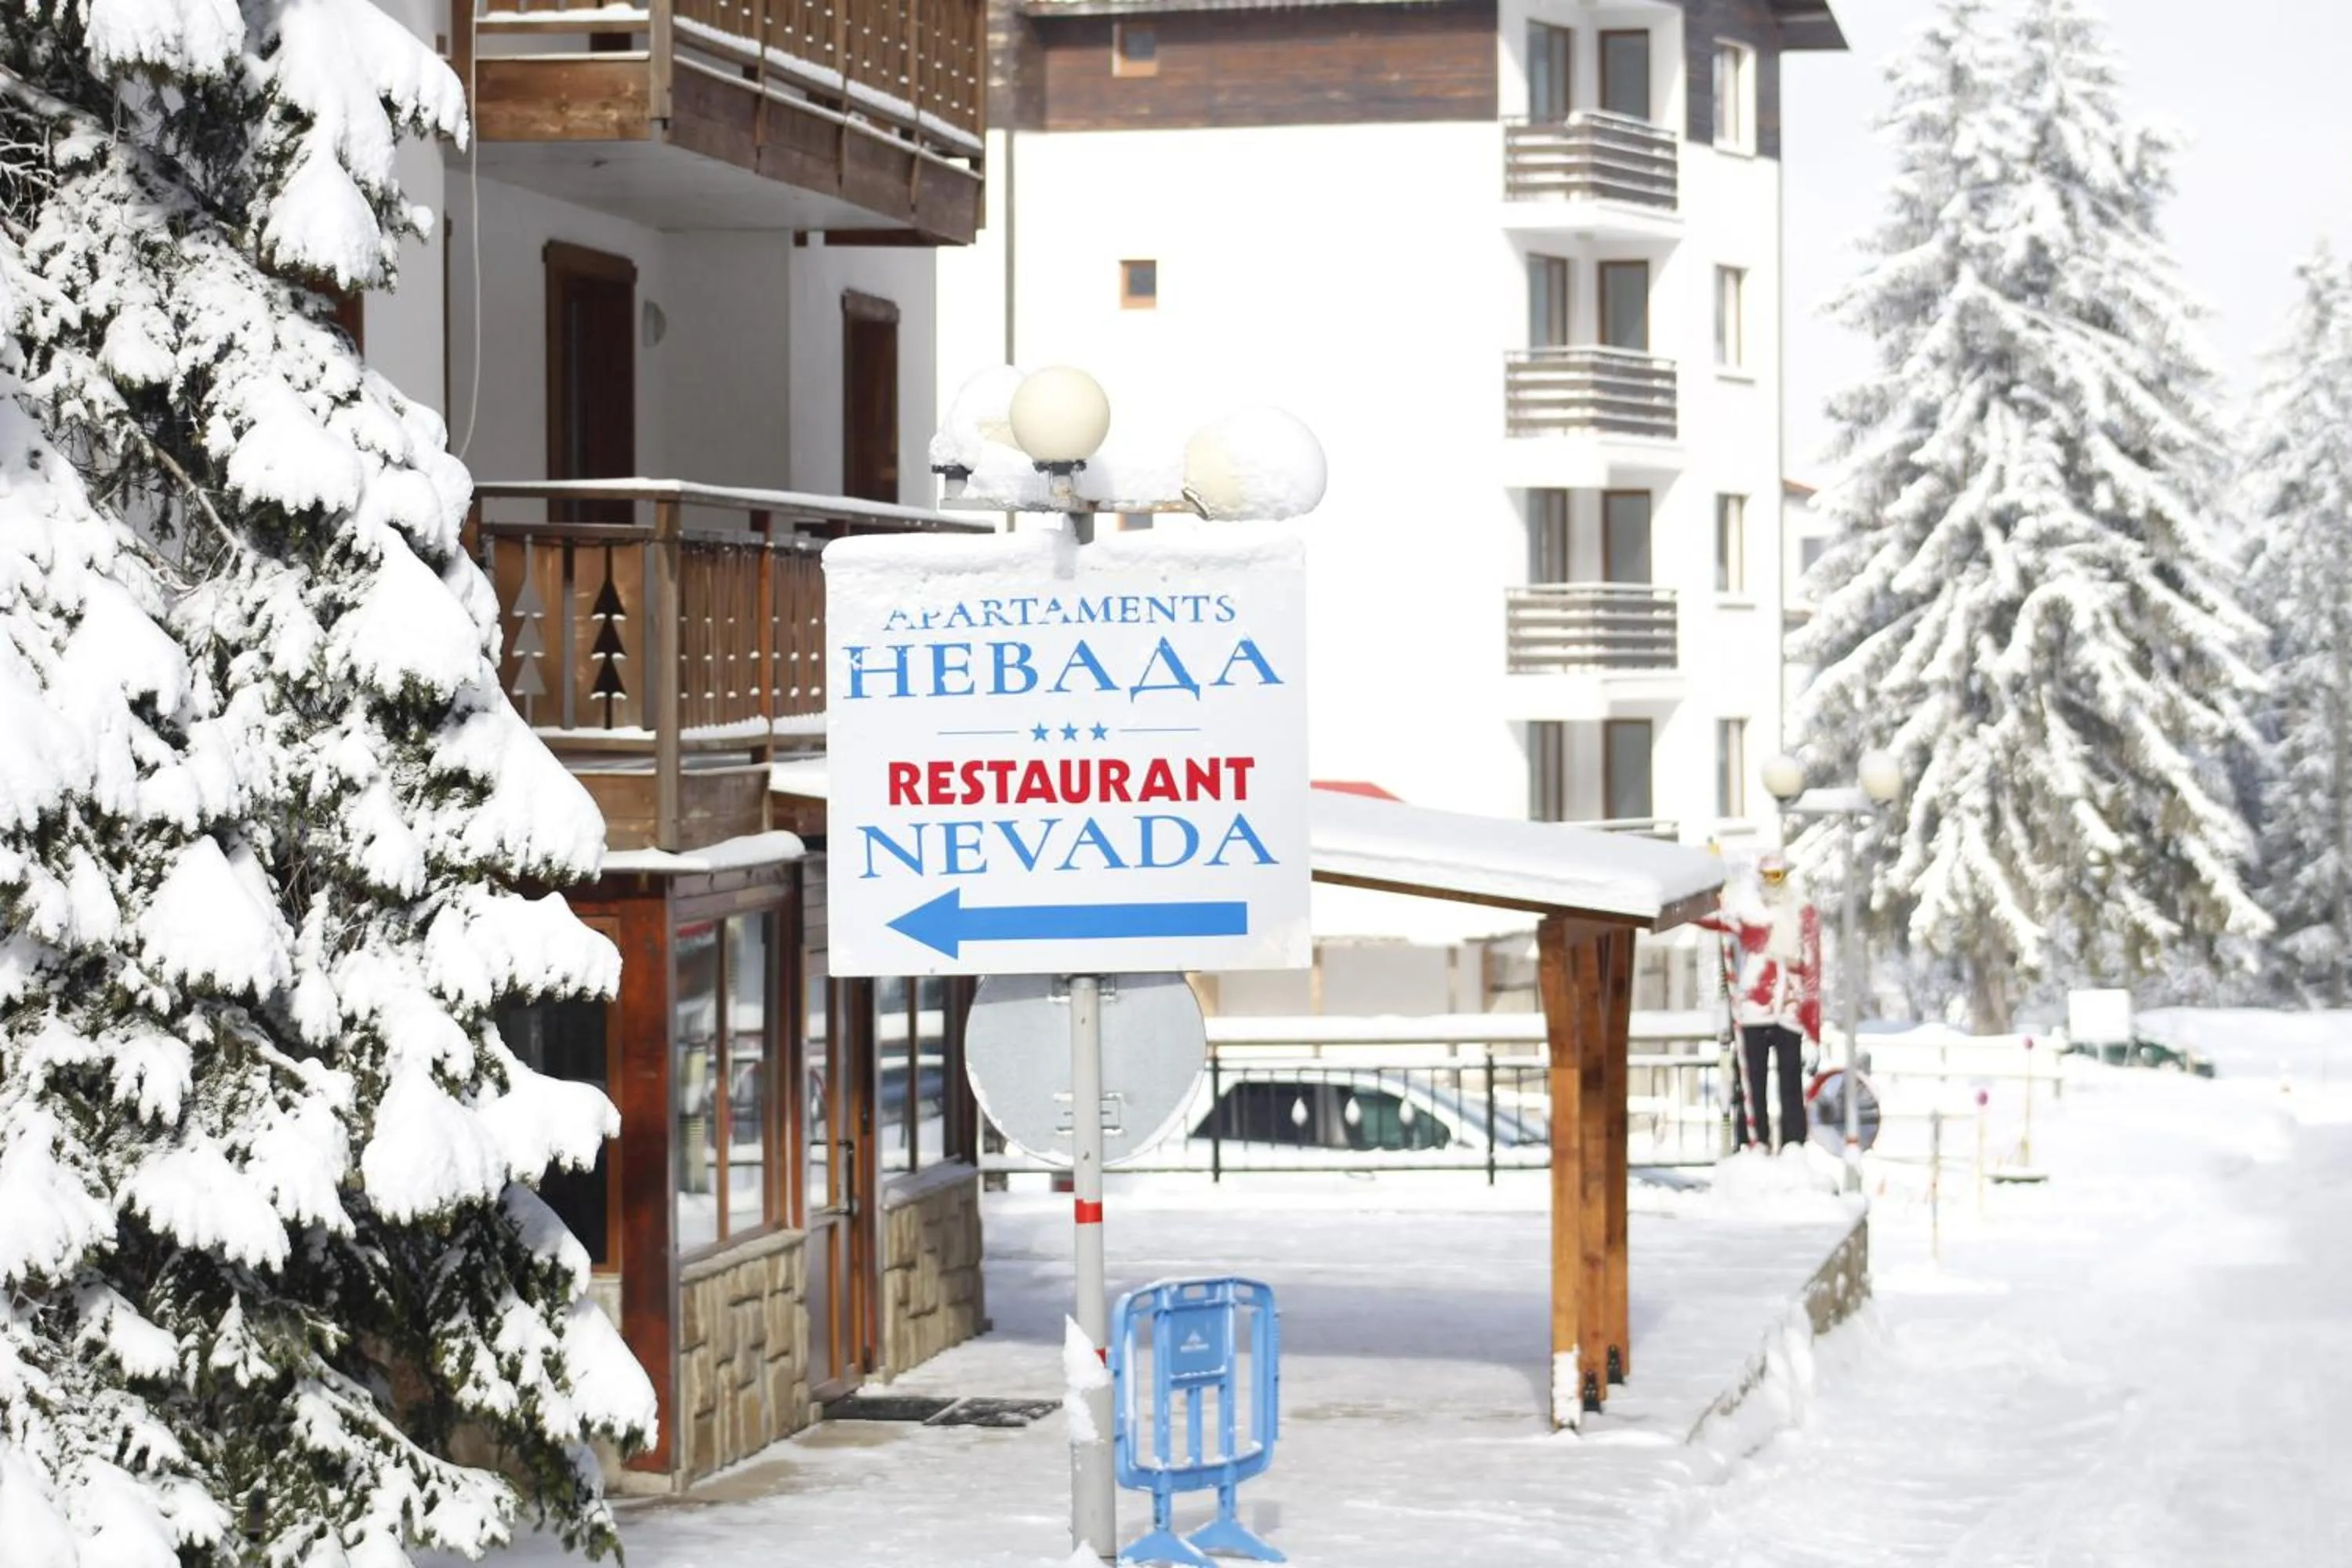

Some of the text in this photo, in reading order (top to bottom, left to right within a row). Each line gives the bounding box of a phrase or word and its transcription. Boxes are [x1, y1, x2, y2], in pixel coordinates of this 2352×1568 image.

[842, 636, 1284, 703] НЕВАДА
[888, 757, 1255, 806] RESTAURANT
[857, 813, 1280, 879] NEVADA
